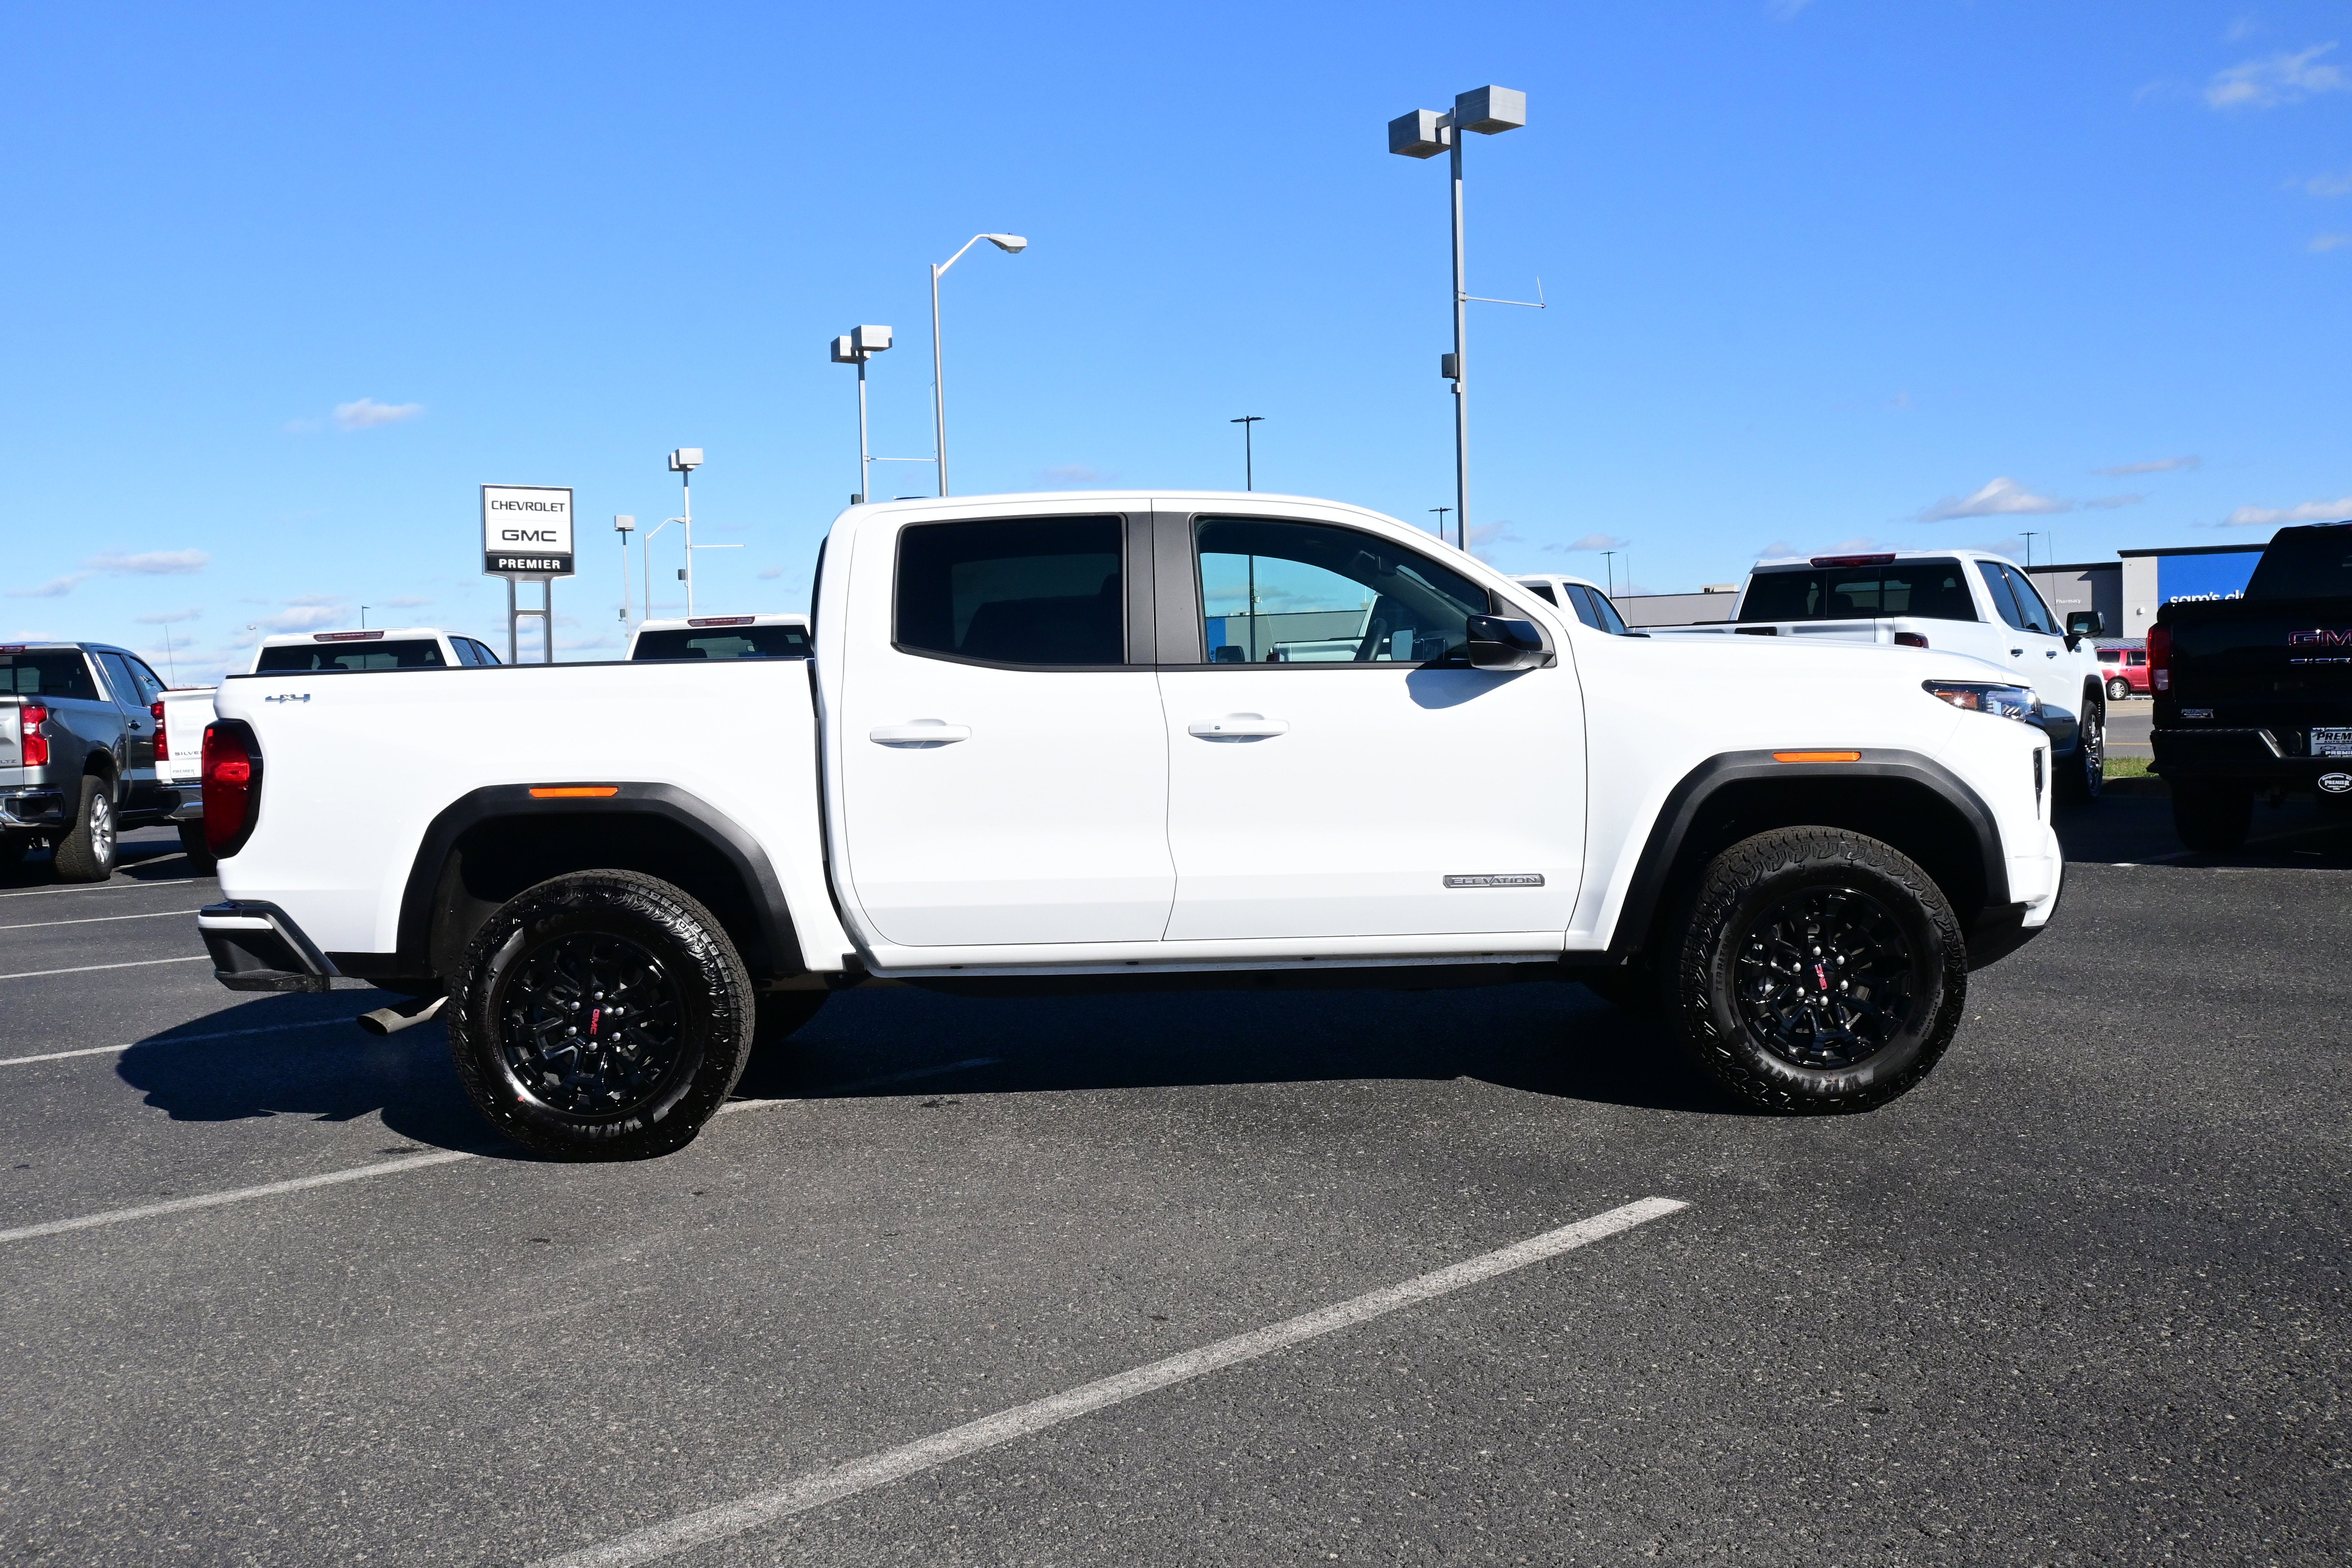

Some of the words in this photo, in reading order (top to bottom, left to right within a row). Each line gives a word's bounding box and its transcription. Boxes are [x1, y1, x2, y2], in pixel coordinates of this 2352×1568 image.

[491, 501, 565, 512] CHEVROLET
[502, 530, 556, 542] GMC
[498, 559, 560, 569] PREMIER
[1814, 963, 1827, 990] GMC
[590, 1009, 600, 1035] GMC
